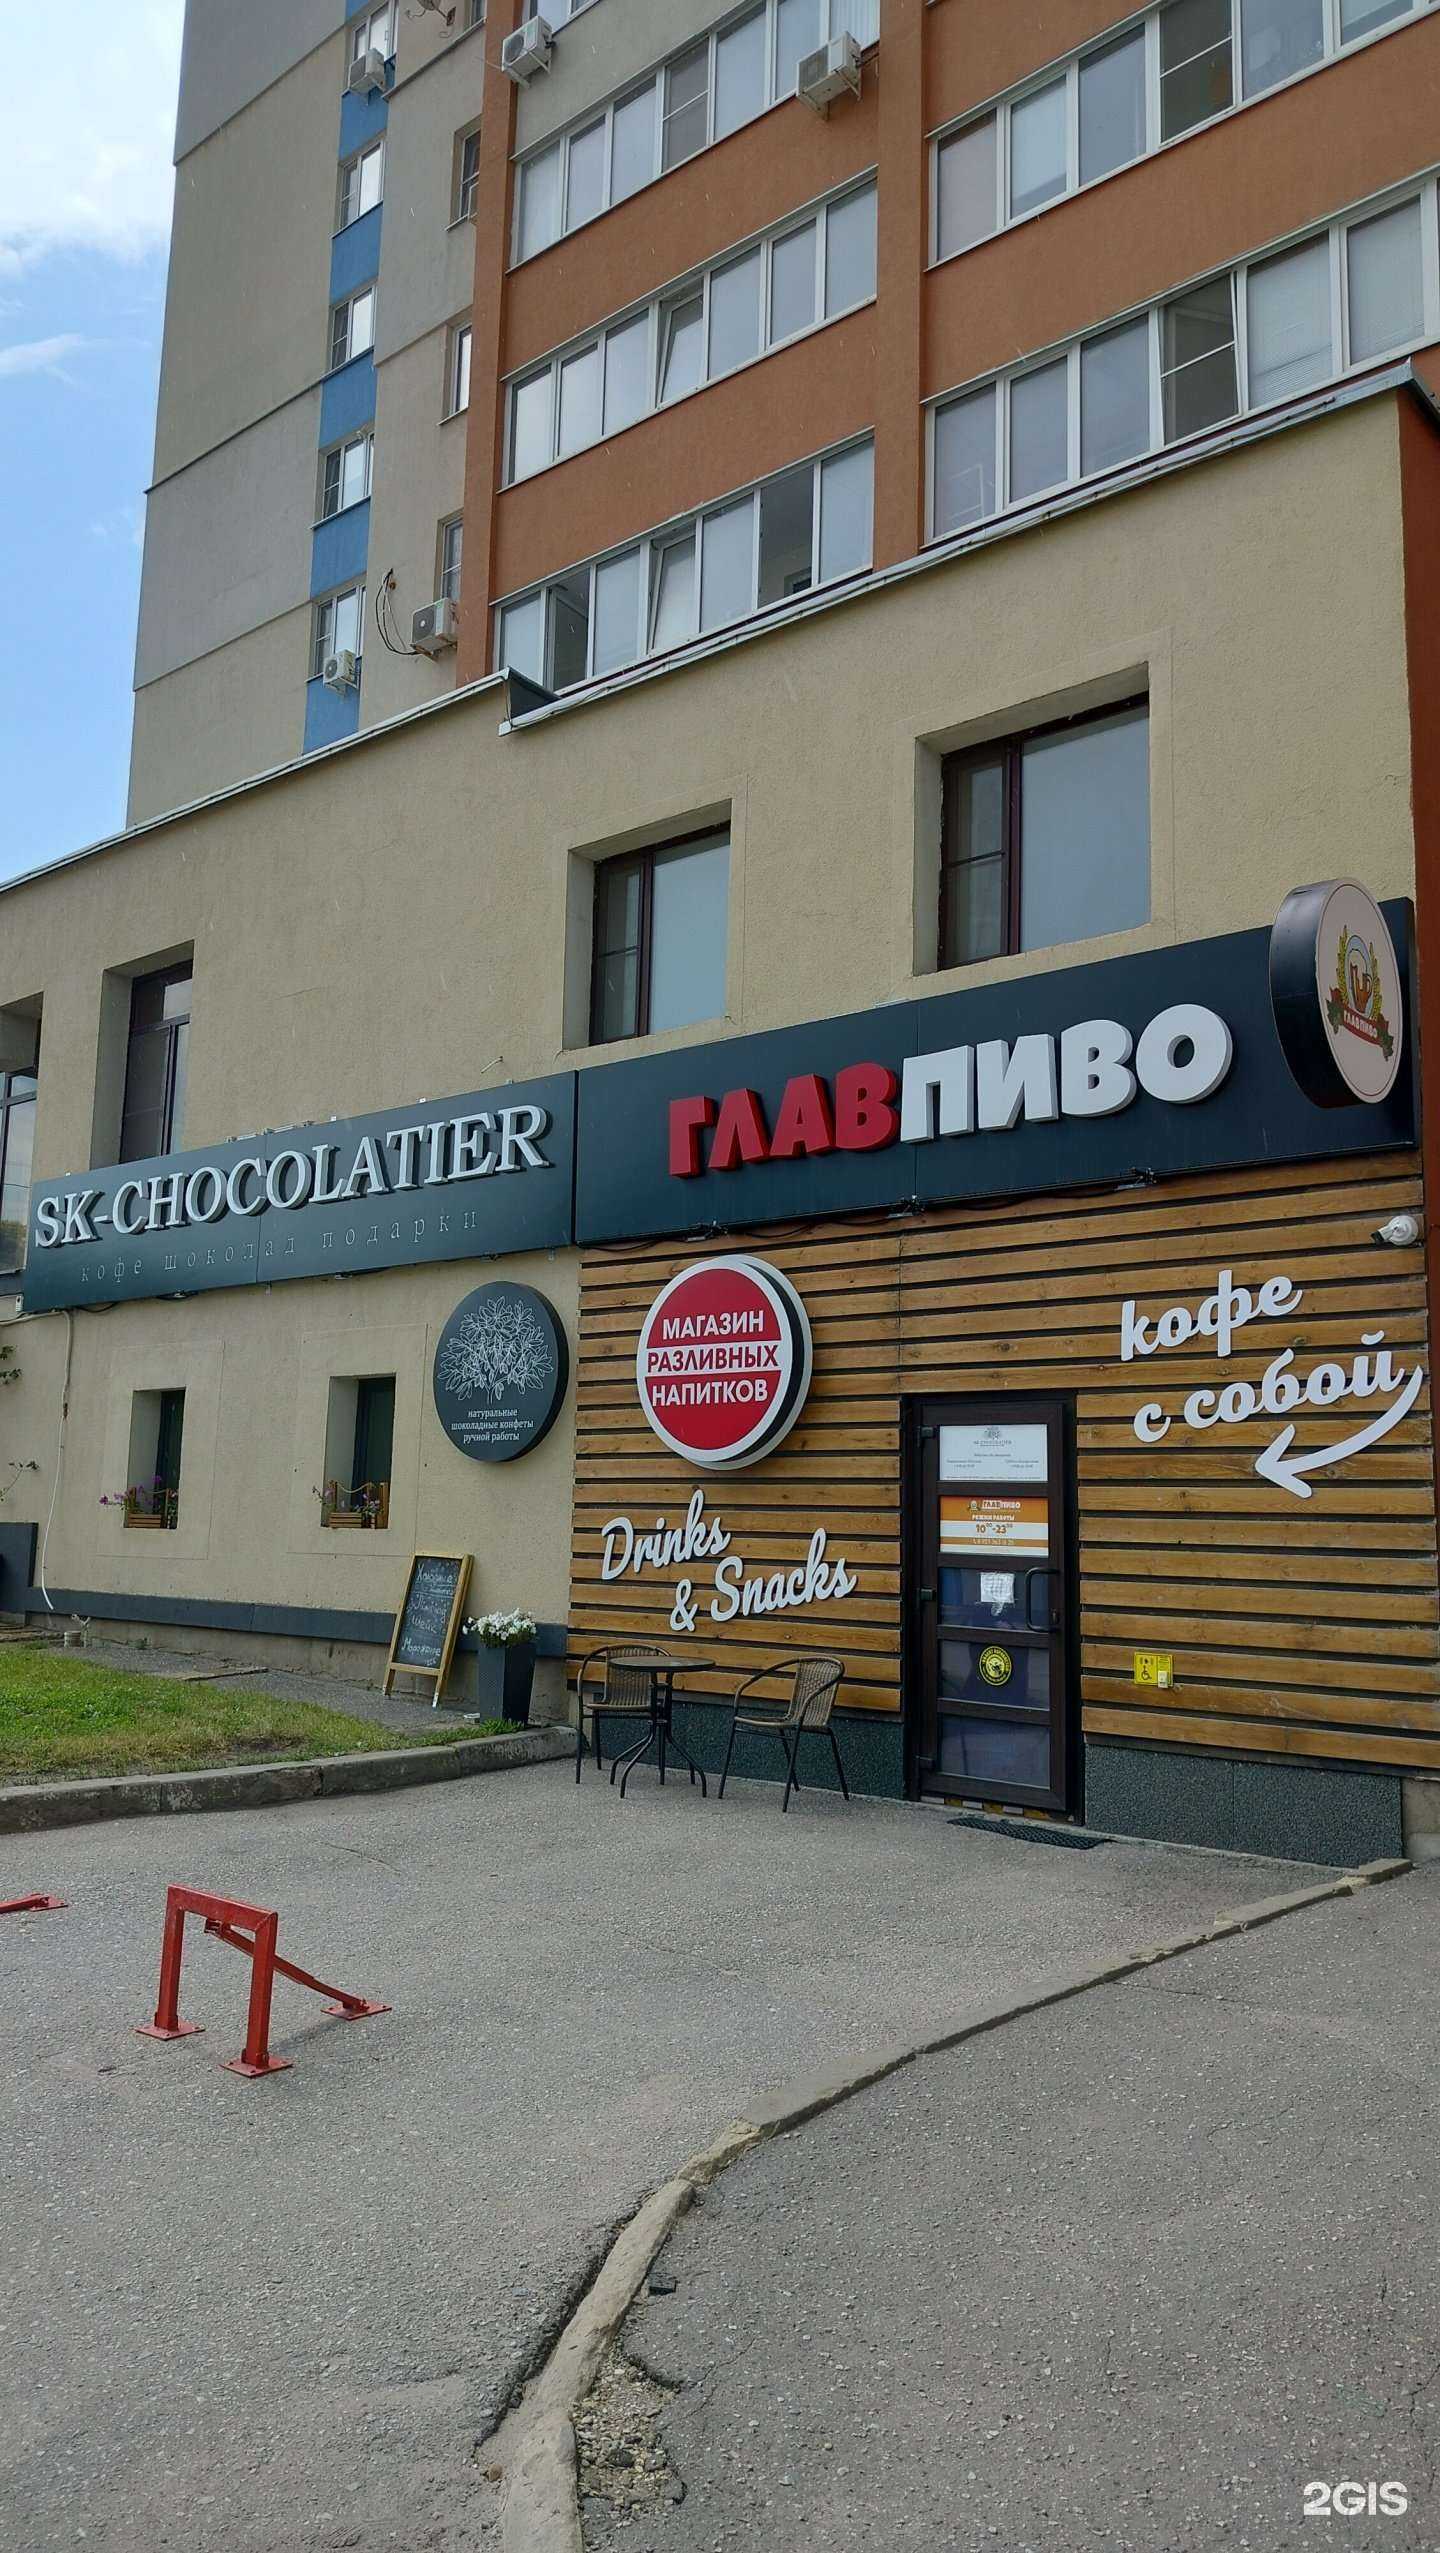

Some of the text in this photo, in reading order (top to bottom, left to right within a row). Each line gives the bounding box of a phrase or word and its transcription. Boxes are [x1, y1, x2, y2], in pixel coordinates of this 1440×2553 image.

[668, 1003, 1233, 1178] ГЛАВПИВО
[34, 1104, 554, 1248] SK-CHOCOLATIER
[81, 1210, 477, 1283] кофе шоколад подарки
[662, 1310, 764, 1341] МАГАЗИН
[1121, 1269, 1303, 1361] кофе
[647, 1344, 779, 1373] РАЗЛИВНЫХ
[652, 1379, 768, 1407] НАПИТКОВ
[1133, 1330, 1405, 1443] с собой
[451, 1418, 534, 1431] шоколадные конфеты
[463, 1431, 519, 1444] ручной работы
[467, 1409, 518, 1420] натуральные
[601, 1489, 731, 1580] Drinks
[669, 1527, 858, 1632] & Snacks
